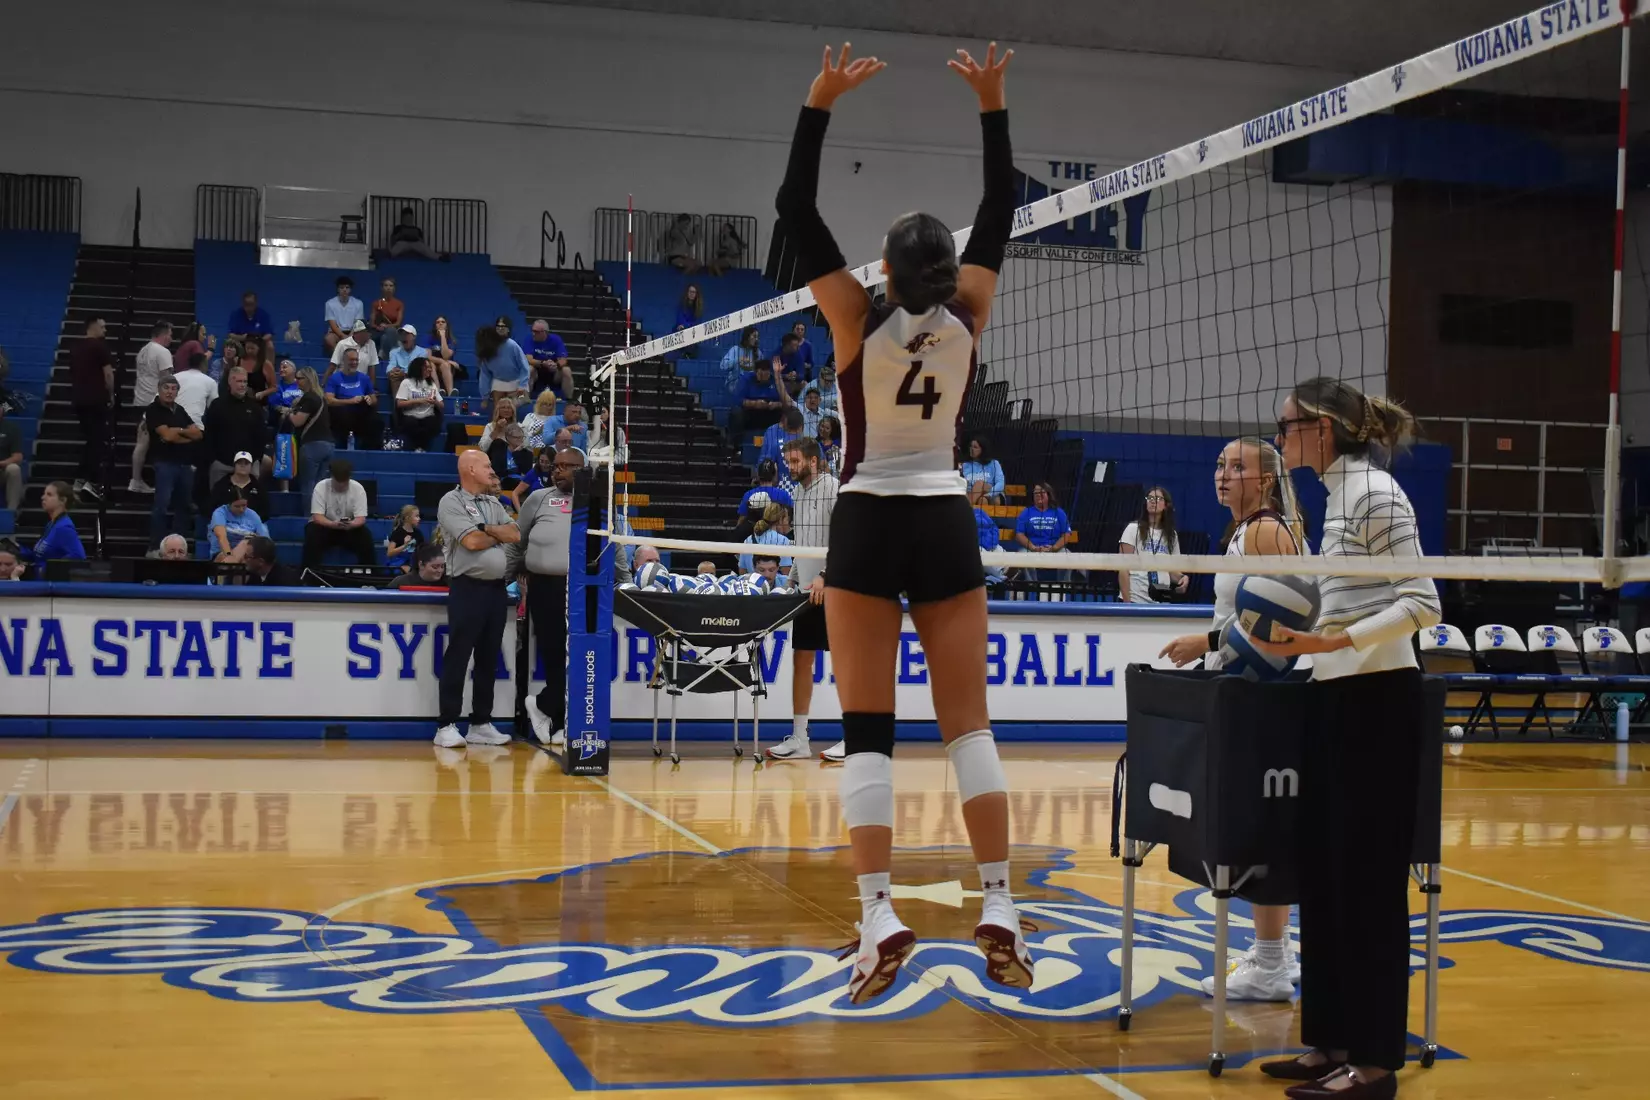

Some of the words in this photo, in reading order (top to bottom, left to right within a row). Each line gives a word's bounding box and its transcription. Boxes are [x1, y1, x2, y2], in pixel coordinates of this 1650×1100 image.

[1455, 16, 1533, 72] INDIANA
[1540, 0, 1610, 40] STATE
[1241, 105, 1296, 149] INDIANA
[1300, 86, 1348, 127] STATE
[1048, 161, 1097, 181] THE
[1088, 169, 1130, 203] INDIANA
[1132, 154, 1166, 188] STATE
[1006, 245, 1042, 257] SSOURI
[1045, 247, 1080, 260] VALLEY
[1081, 251, 1142, 263] CONFERENCE
[895, 360, 942, 420] 4
[701, 616, 741, 627] molten
[91, 619, 295, 679] STATE
[585, 650, 595, 683] sports
[584, 684, 595, 725] imports
